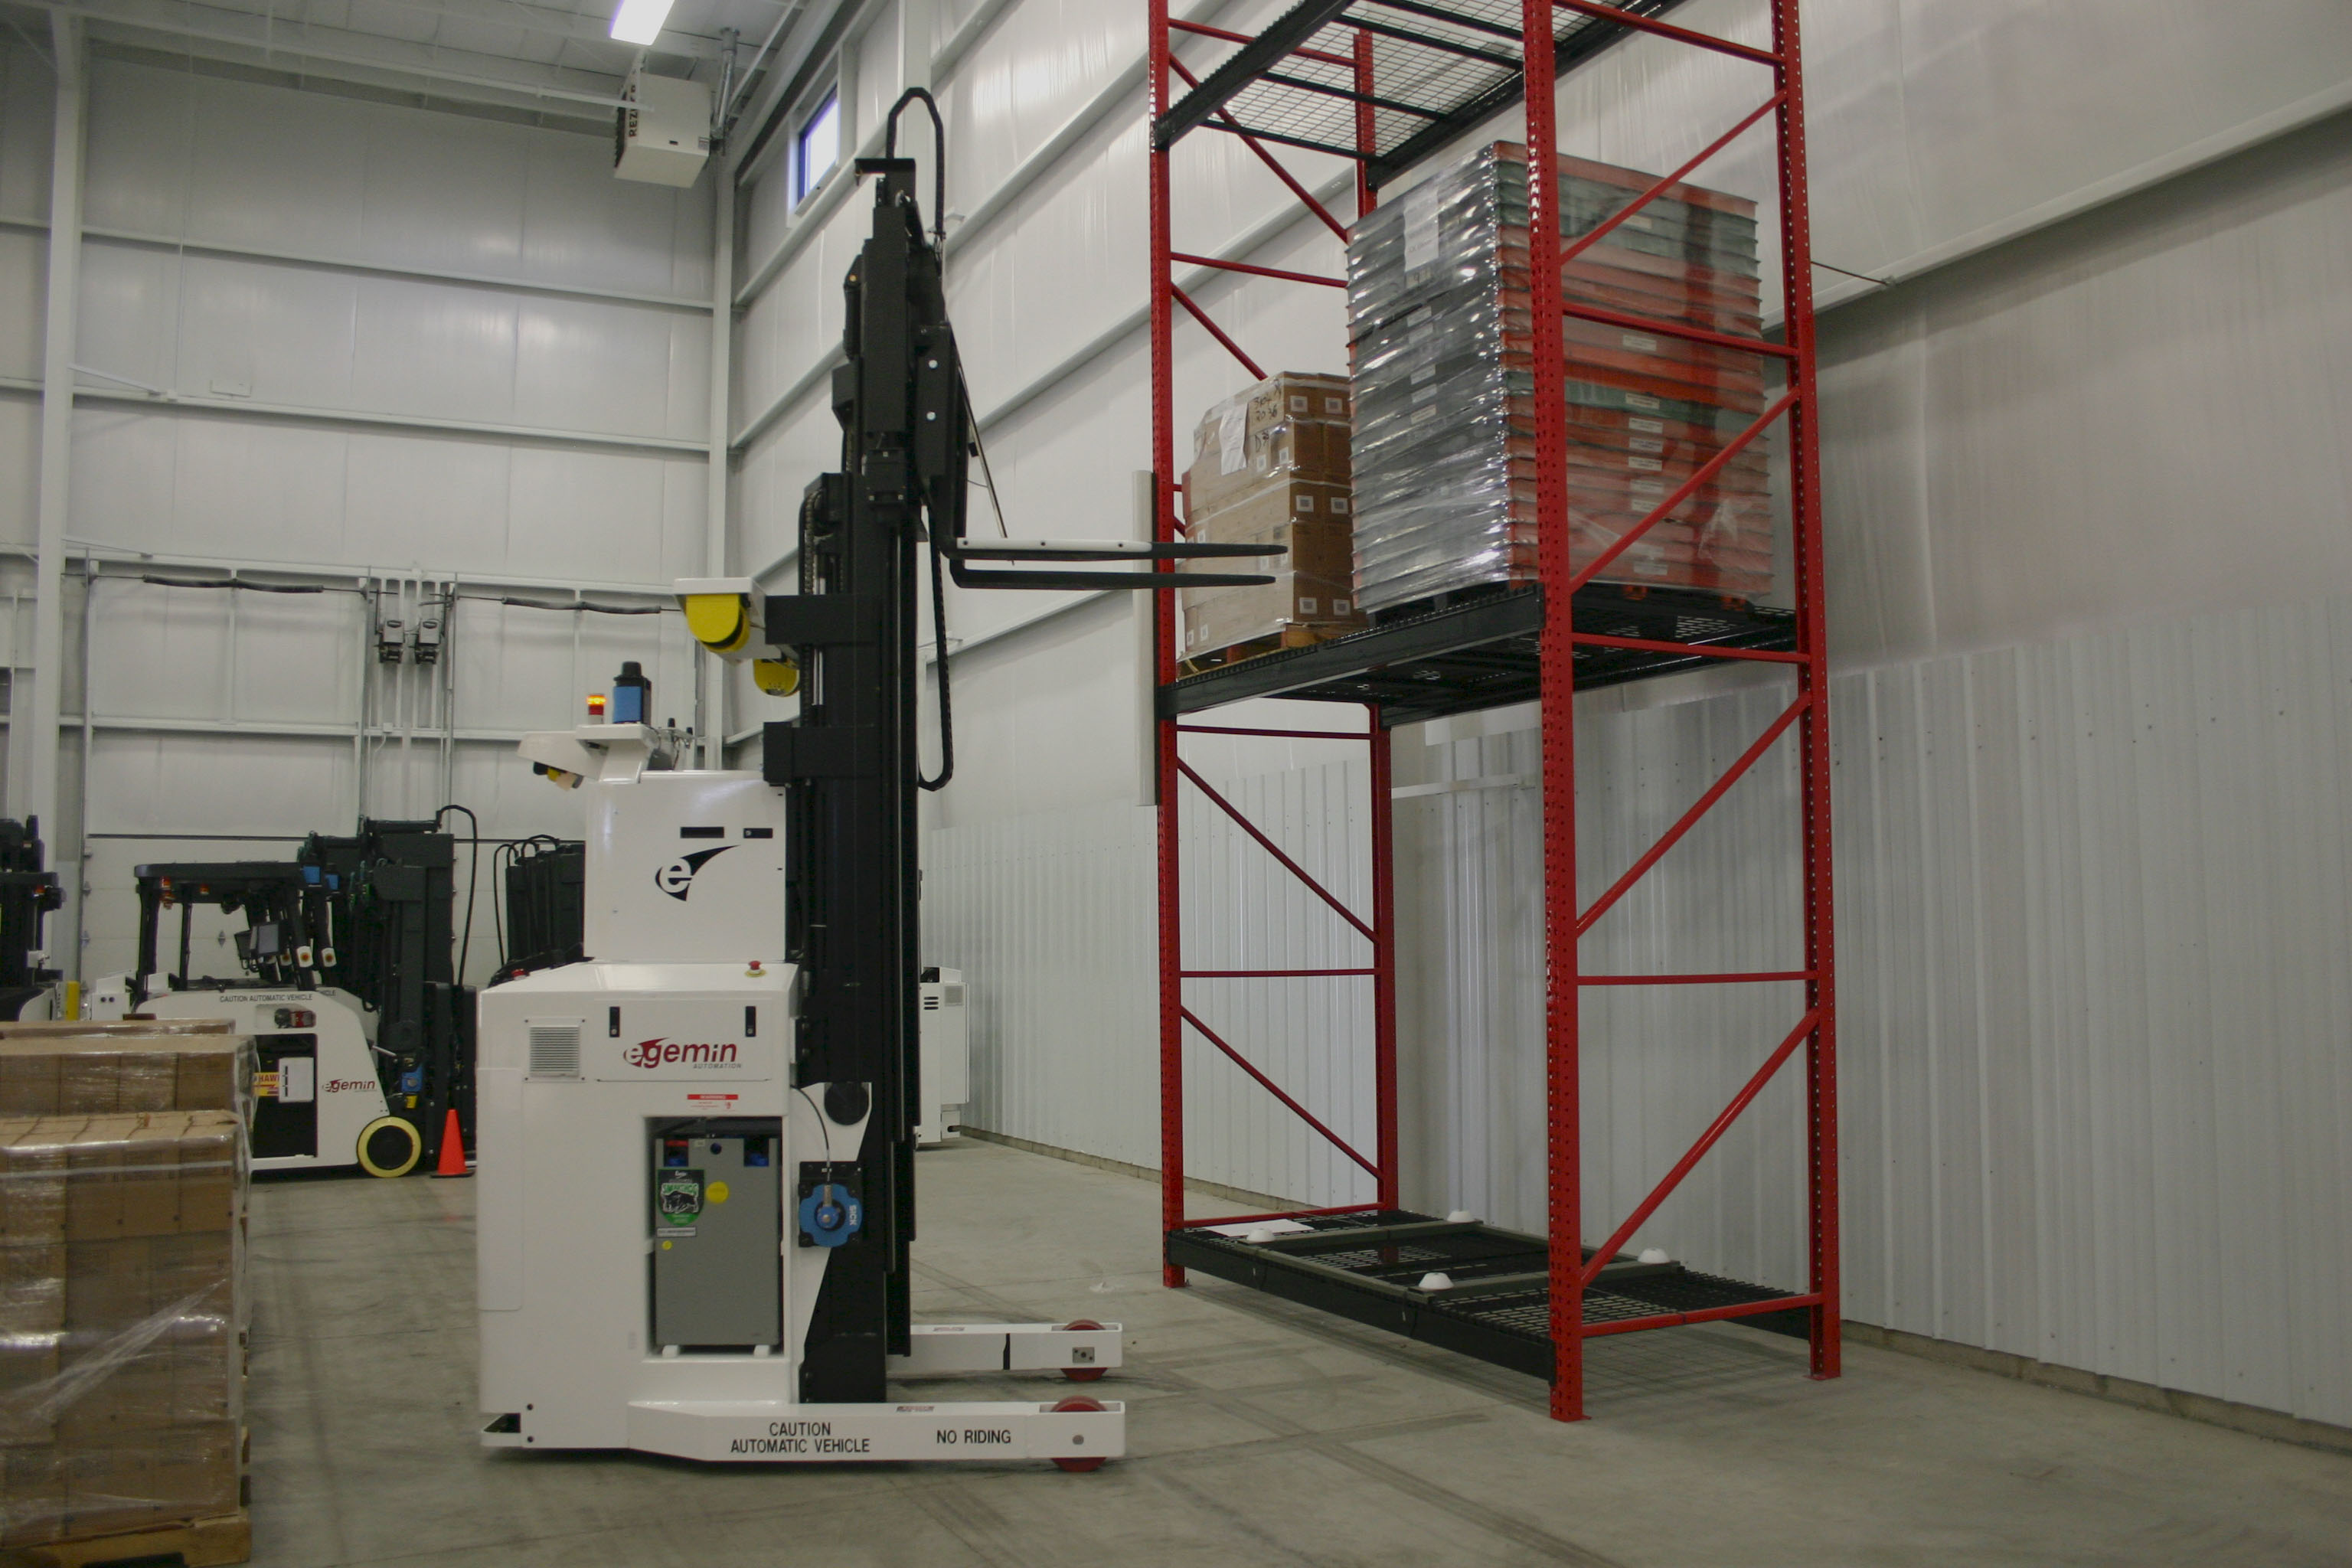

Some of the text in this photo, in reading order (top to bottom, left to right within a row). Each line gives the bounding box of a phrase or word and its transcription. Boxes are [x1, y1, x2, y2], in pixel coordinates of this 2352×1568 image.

[623, 1037, 737, 1069] egemin
[259, 1073, 280, 1083] HAW
[322, 1079, 376, 1093] egemin
[849, 1204, 858, 1226] SICK
[769, 1422, 831, 1437] CAUTION
[936, 1429, 1011, 1444] NO RIDING
[730, 1438, 871, 1454] AUTOMATIC VEHICLE
